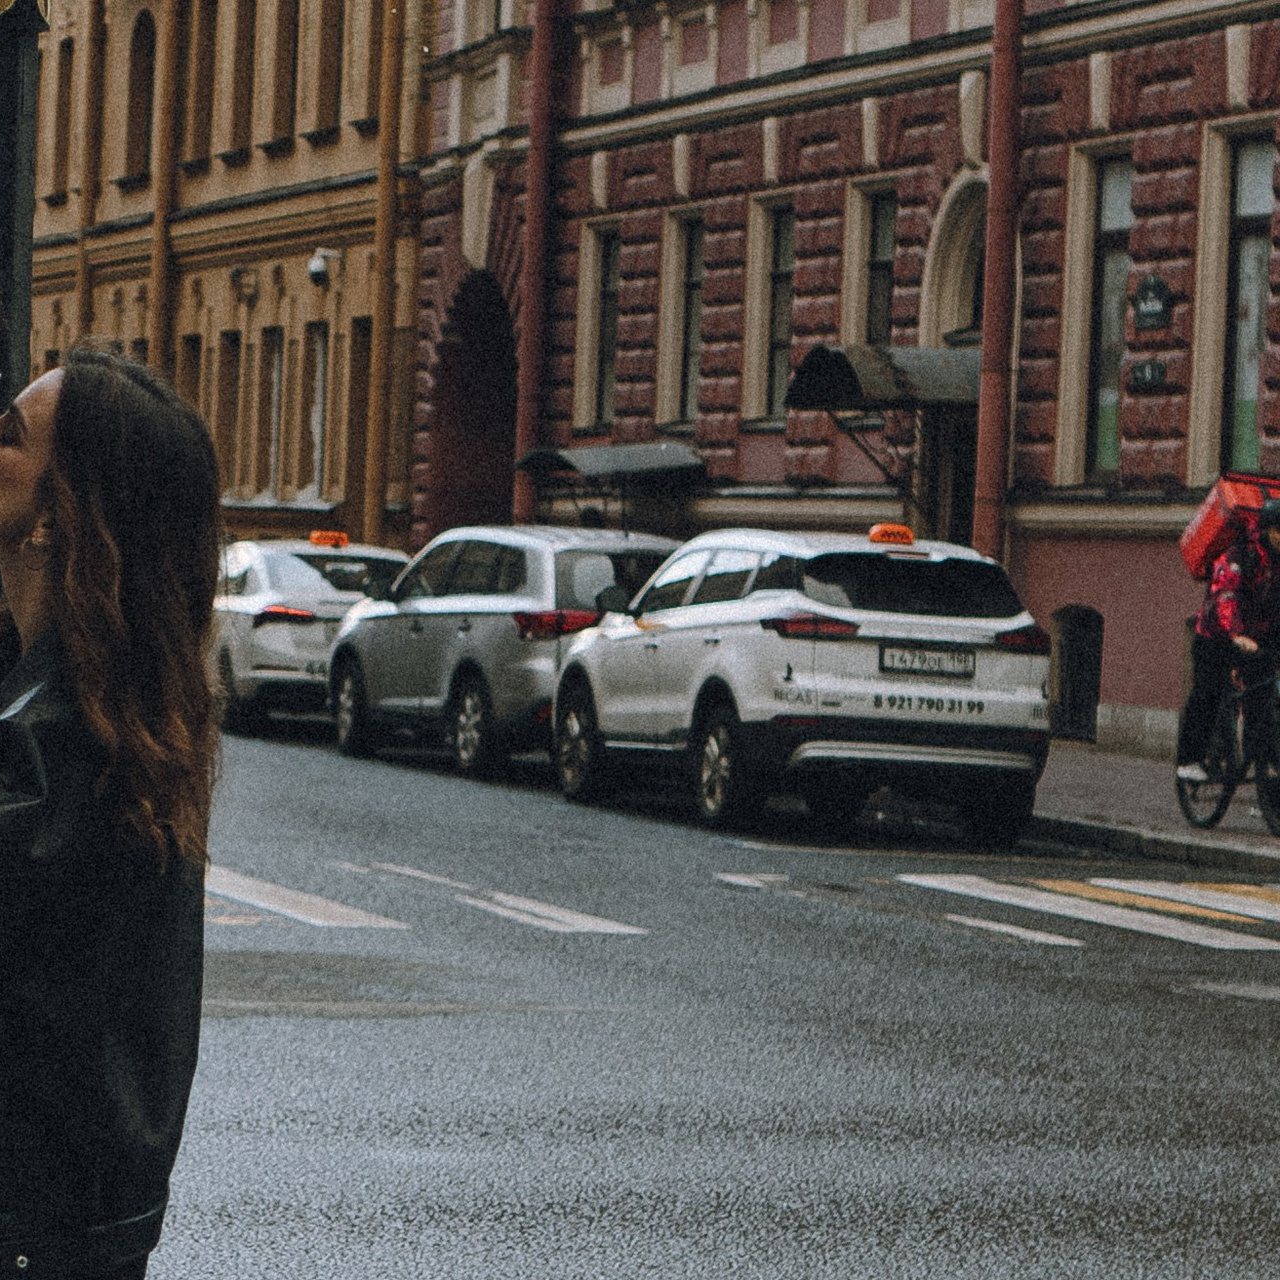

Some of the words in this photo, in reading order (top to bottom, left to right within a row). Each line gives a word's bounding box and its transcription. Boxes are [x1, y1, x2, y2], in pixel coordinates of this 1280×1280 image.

[873, 694, 883, 710] 8
[887, 695, 913, 711] 921
[967, 699, 985, 715] 99
